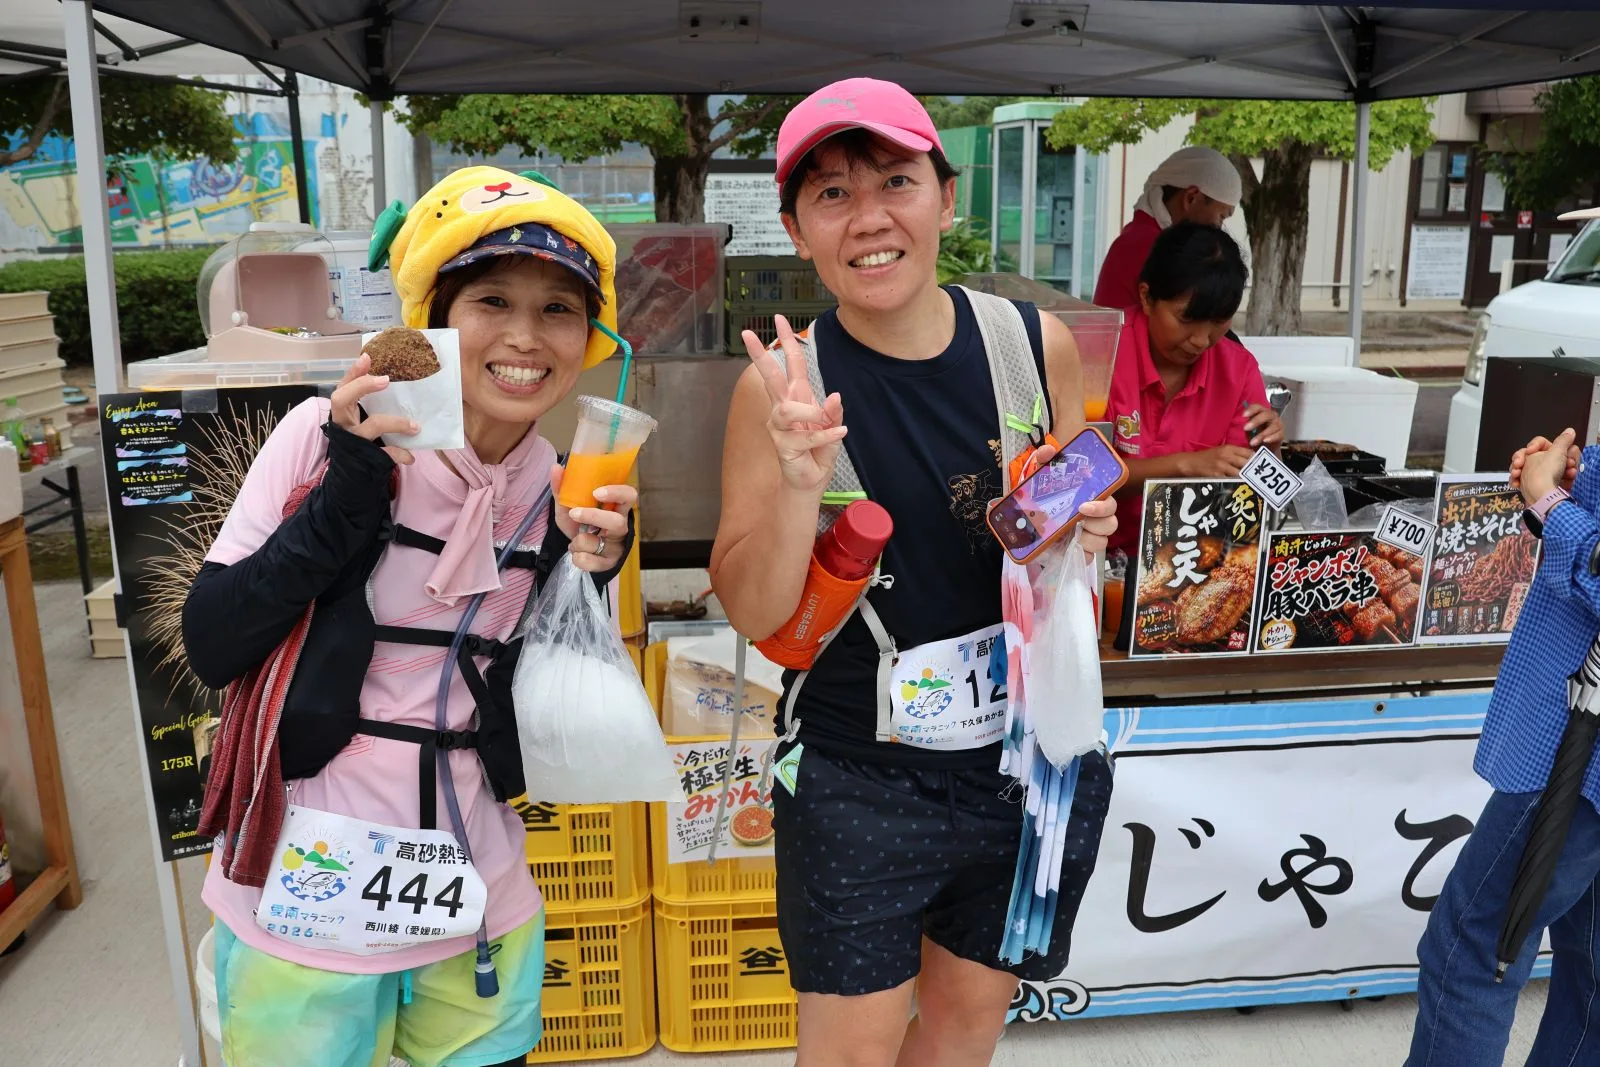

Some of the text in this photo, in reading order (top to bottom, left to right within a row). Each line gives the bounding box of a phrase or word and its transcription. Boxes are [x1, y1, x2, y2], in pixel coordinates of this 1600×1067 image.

[106, 397, 159, 419] Enjoy Area
[1254, 458, 1291, 496] ¥250
[1225, 484, 1257, 543] 炙り
[1388, 516, 1426, 545] ¥700
[1166, 484, 1218, 588] じゃこ天
[1435, 510, 1524, 557] 焼きそば
[1270, 545, 1369, 590] ジャンボ！
[1263, 570, 1380, 621] 豚バラ串
[152, 708, 213, 741] Special Guest
[960, 709, 1004, 729] 下久保 あかね
[161, 755, 195, 772] 175R
[361, 865, 464, 918] 444
[267, 922, 314, 938] 2026
